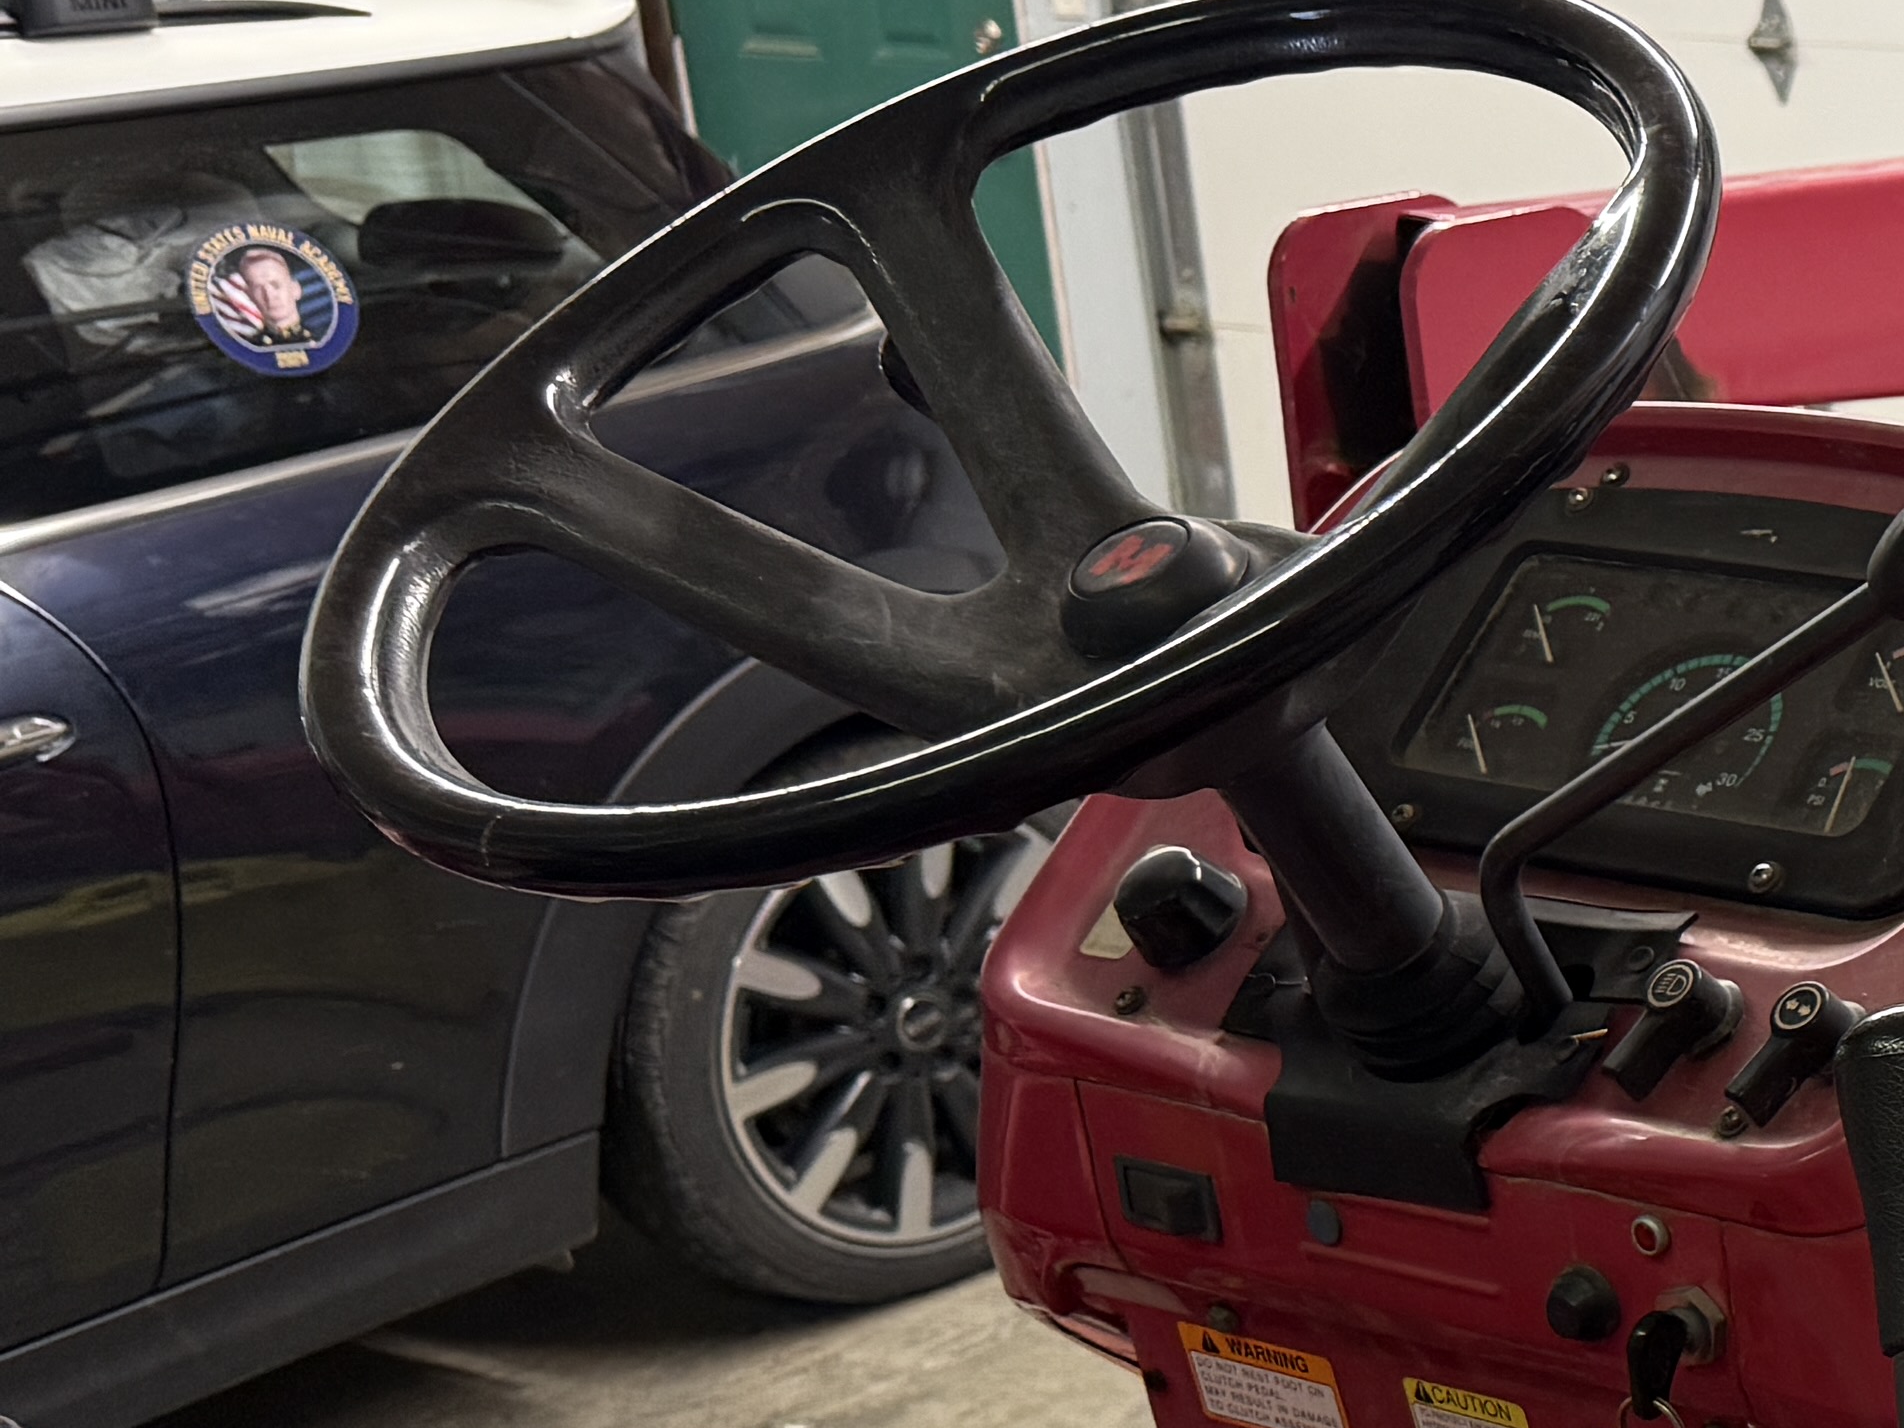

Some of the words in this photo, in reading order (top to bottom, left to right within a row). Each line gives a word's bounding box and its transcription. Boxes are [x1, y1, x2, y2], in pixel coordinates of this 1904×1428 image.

[197, 225, 246, 264] STATES
[247, 224, 295, 247] NAVAL
[1669, 677, 1687, 692] 10
[1623, 710, 1638, 724] 5
[1742, 728, 1766, 743] 25
[1716, 772, 1738, 788] 30
[1224, 1337, 1309, 1373] WARNING
[1215, 1361, 1237, 1374] NOT
[1200, 1371, 1243, 1389] CLUTCH
[1204, 1385, 1226, 1397] MAY
[1230, 1391, 1272, 1410] RESULT
[1291, 1407, 1337, 1427] DAMAGE
[1430, 1385, 1511, 1420] CAUTION
[1226, 1403, 1270, 1422] CLUTCH
